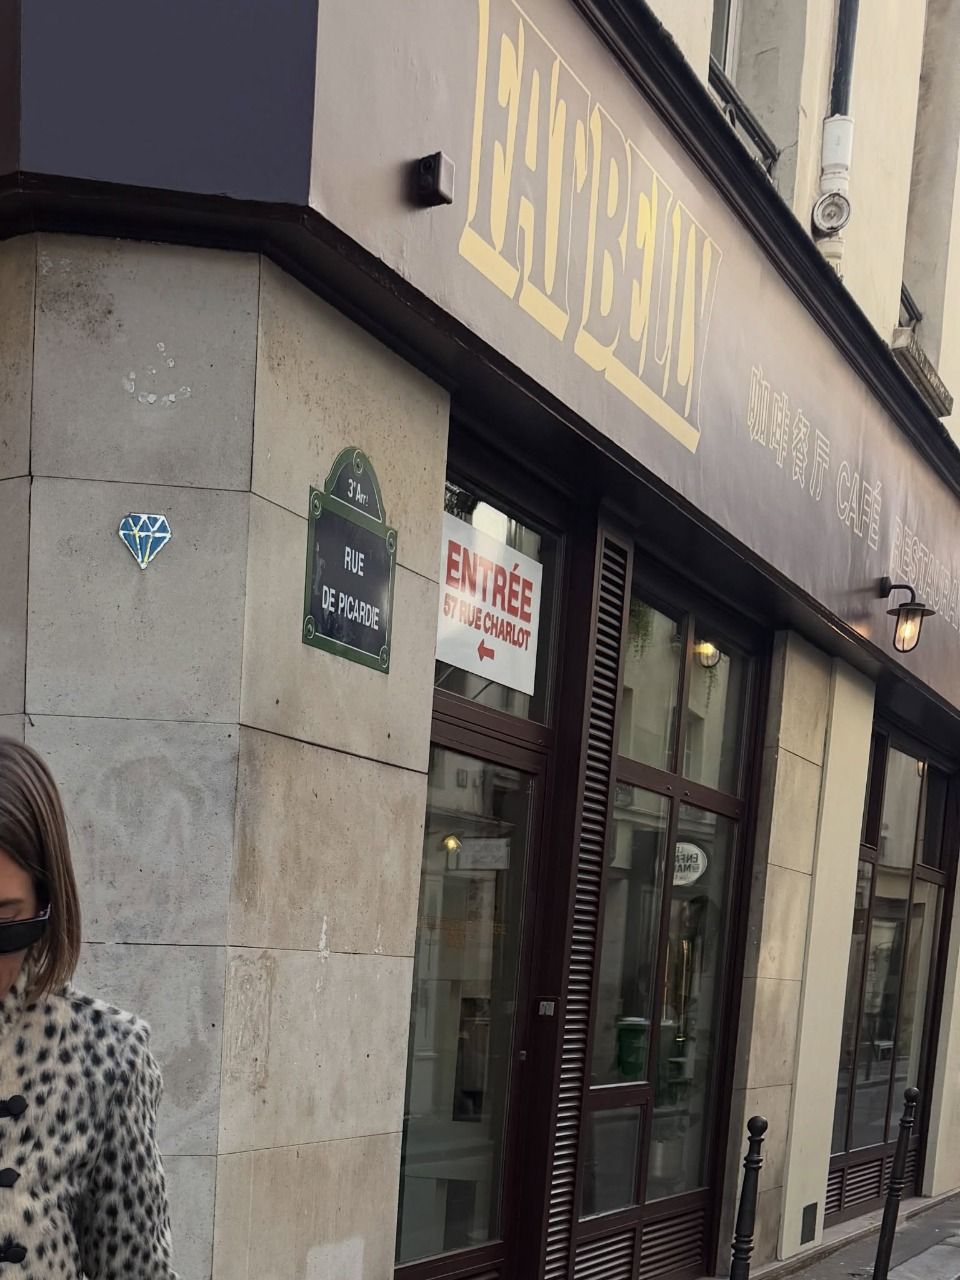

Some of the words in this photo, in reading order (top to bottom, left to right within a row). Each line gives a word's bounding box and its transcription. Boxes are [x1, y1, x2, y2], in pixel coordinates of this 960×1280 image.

[747, 365, 830, 501] 咖啡餐厅
[836, 460, 882, 550] CAFÉ
[344, 546, 364, 577] RUE
[445, 539, 533, 624] ENTRÉE
[321, 585, 336, 613] DE
[338, 592, 380, 630] PICARDIE
[443, 593, 458, 618] 57
[459, 600, 482, 631] RUE
[483, 611, 531, 651] CHARLOT
